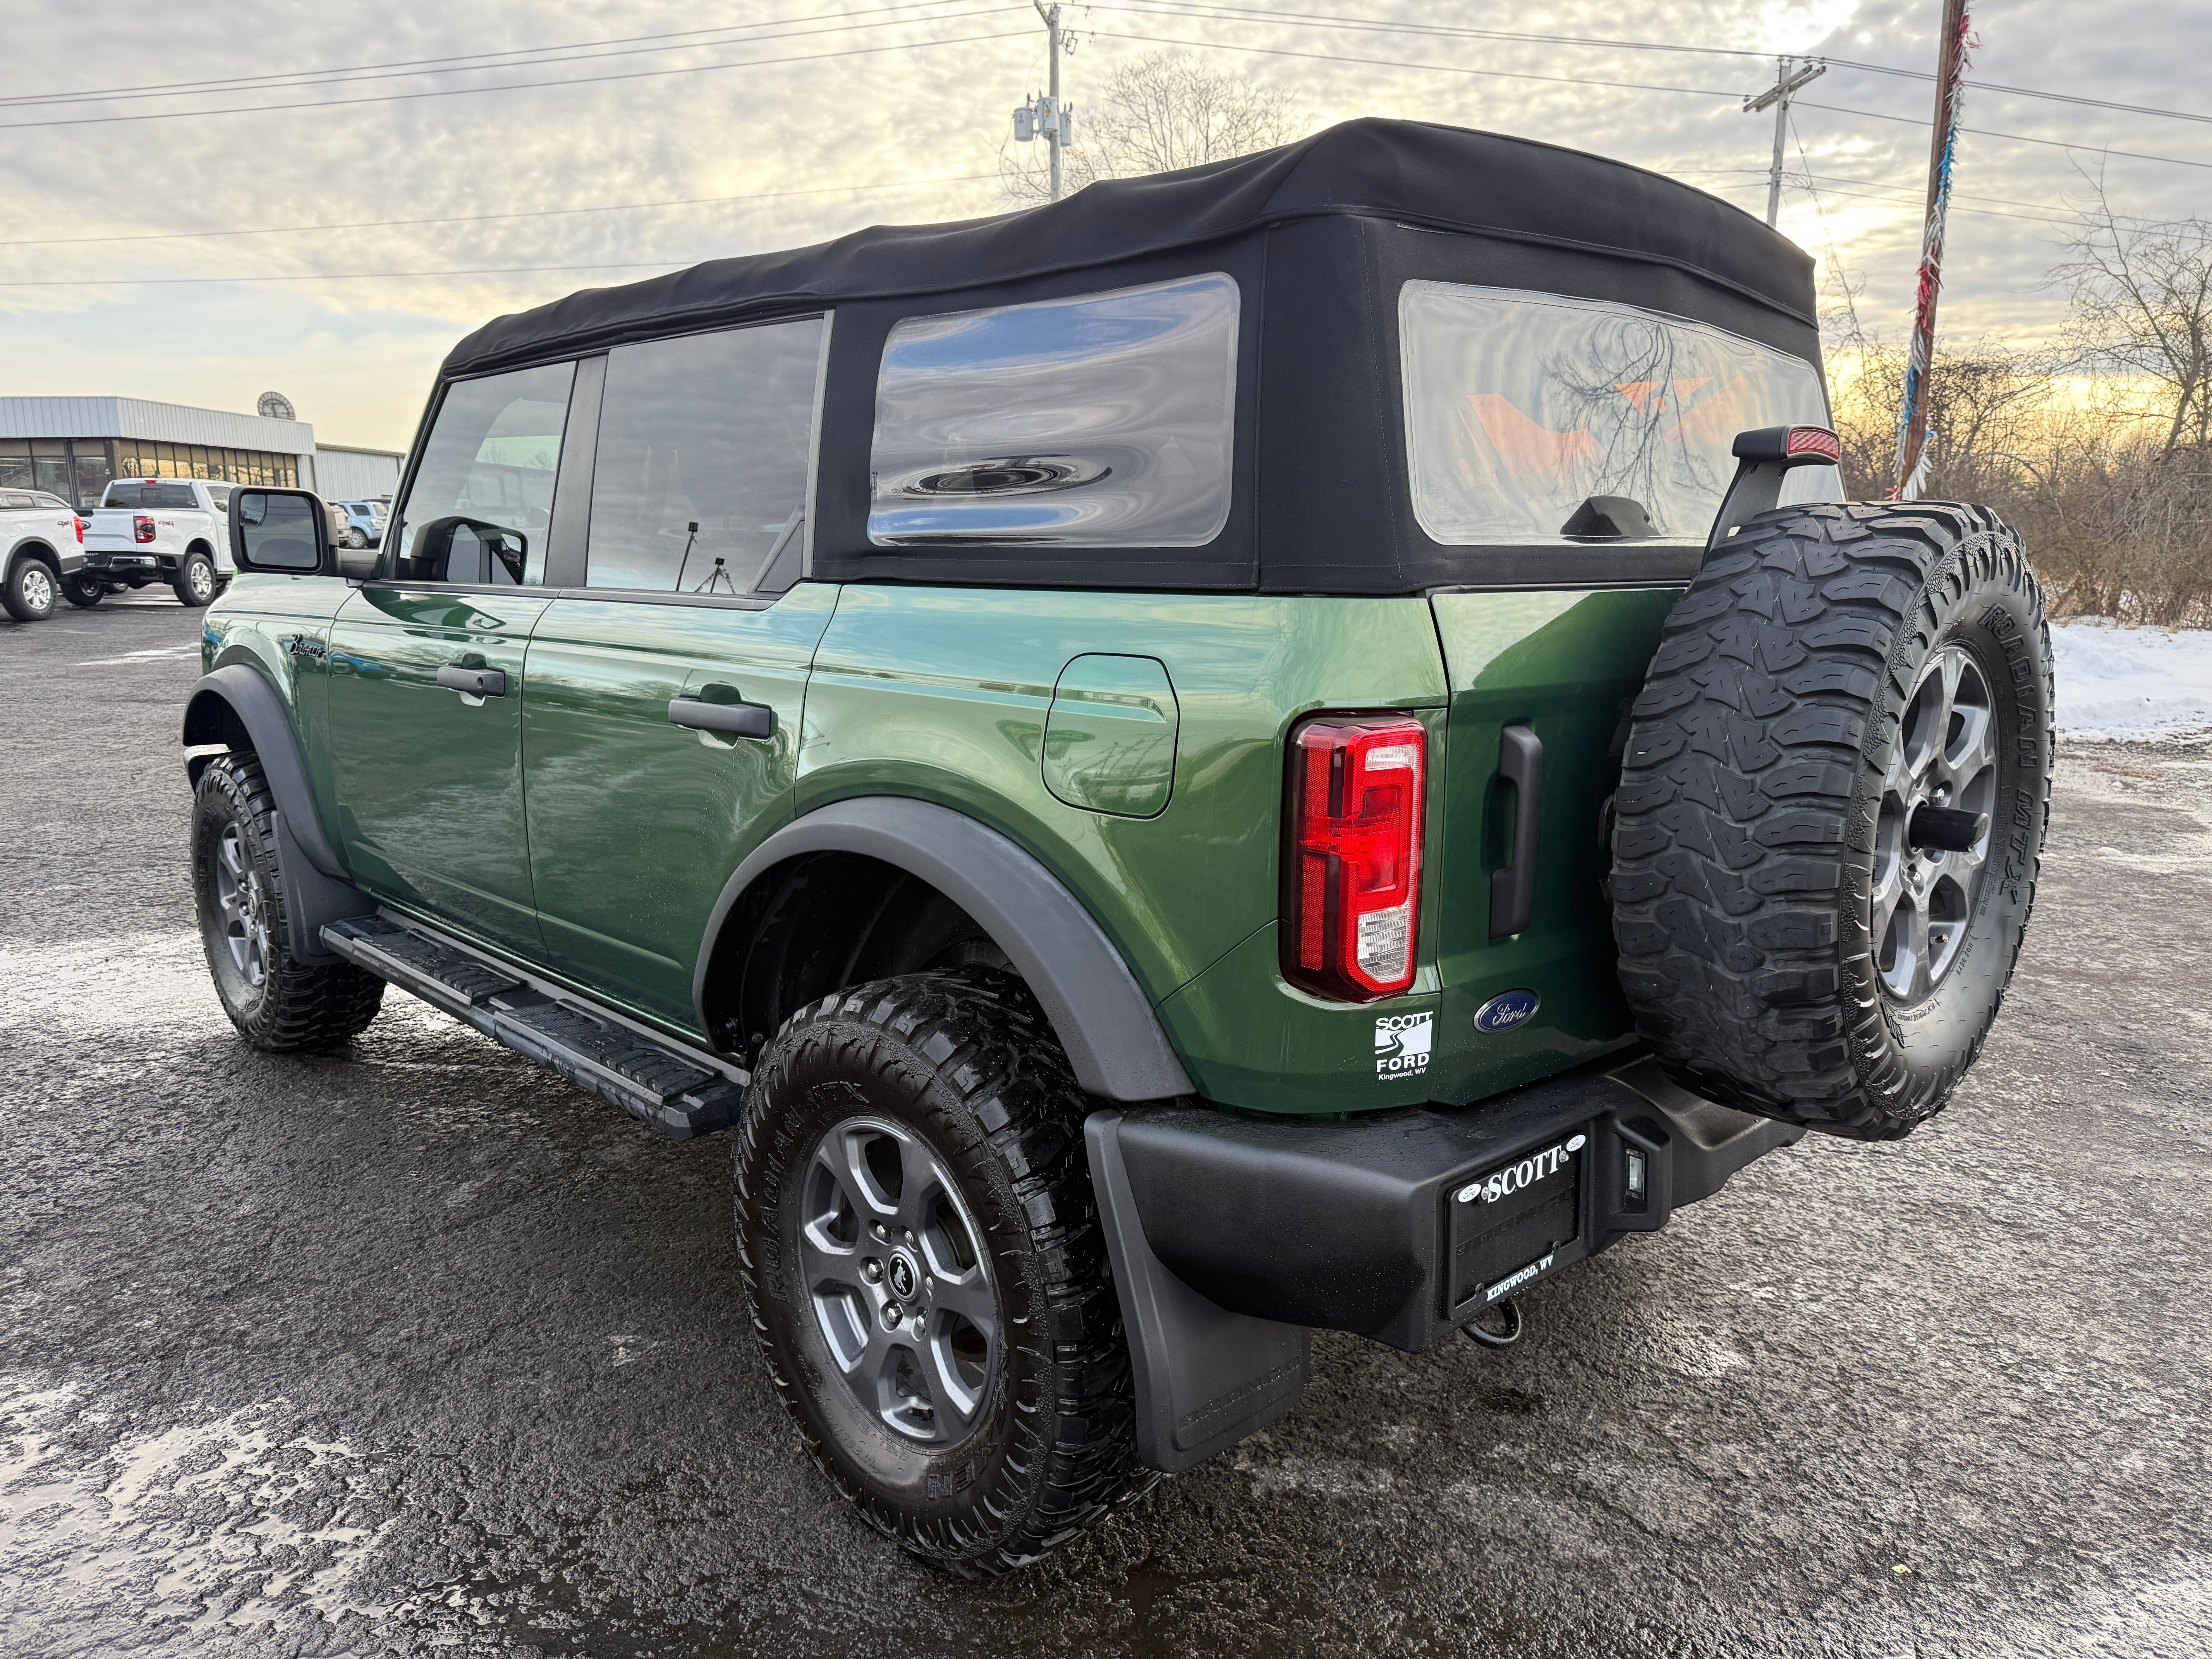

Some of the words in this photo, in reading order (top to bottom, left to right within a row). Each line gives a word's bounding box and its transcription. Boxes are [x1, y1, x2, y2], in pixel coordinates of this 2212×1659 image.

[288, 633, 328, 660] Bronco
[1977, 603, 2037, 768] ROADIAN
[1999, 788, 2034, 905] MTX
[1376, 1011, 1433, 1030] SCOTT
[1492, 1000, 1527, 1026] Ford
[1376, 1053, 1429, 1072] FORD
[1378, 1070, 1413, 1080] Kingwood,
[1487, 1145, 1562, 1204] SCOTT
[1487, 1265, 1538, 1302] KINGWOOD,
[1540, 1254, 1553, 1270] WV
